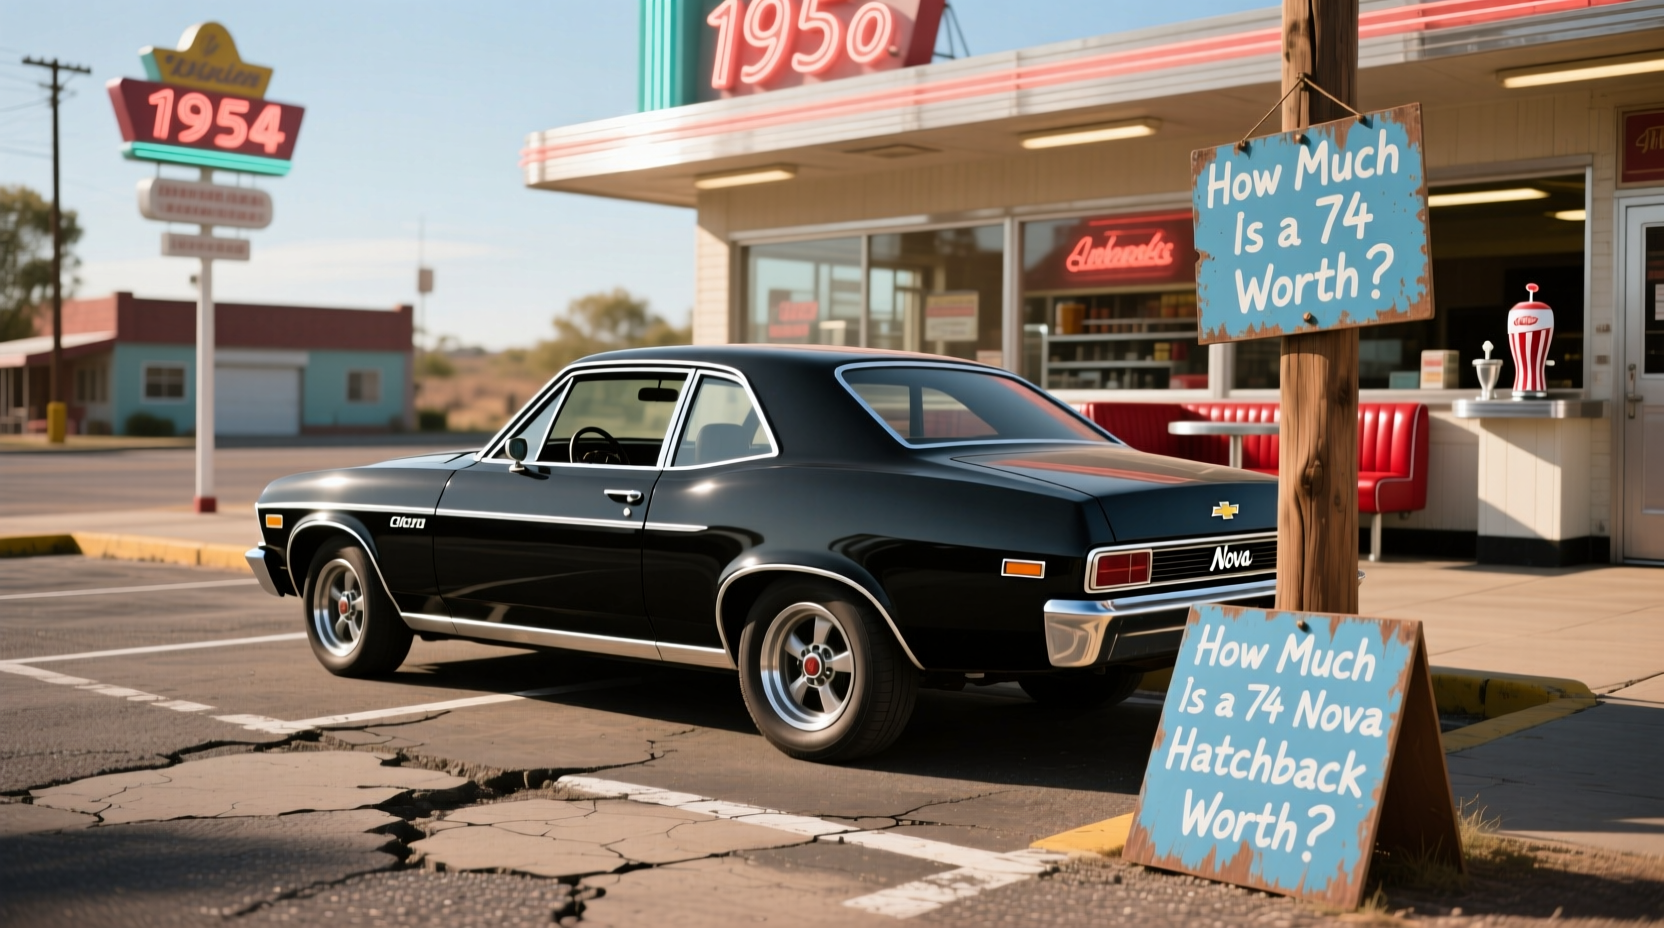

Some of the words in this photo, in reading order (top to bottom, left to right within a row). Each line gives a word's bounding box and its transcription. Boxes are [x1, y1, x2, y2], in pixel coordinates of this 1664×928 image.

[148, 88, 286, 154] 1954
[1207, 160, 1283, 209] How
[1294, 128, 1400, 191] Much
[1234, 211, 1264, 256] Is
[1277, 217, 1302, 248] a
[1315, 191, 1374, 245] 74
[1209, 544, 1253, 572] Nova
[1194, 623, 1270, 671] How
[1275, 632, 1376, 683] Much
[1178, 676, 1207, 714] Is
[1214, 692, 1236, 719] a
[1245, 682, 1285, 725] 74
[1291, 689, 1384, 738] Nova
[1165, 725, 1367, 799] Hatchback
